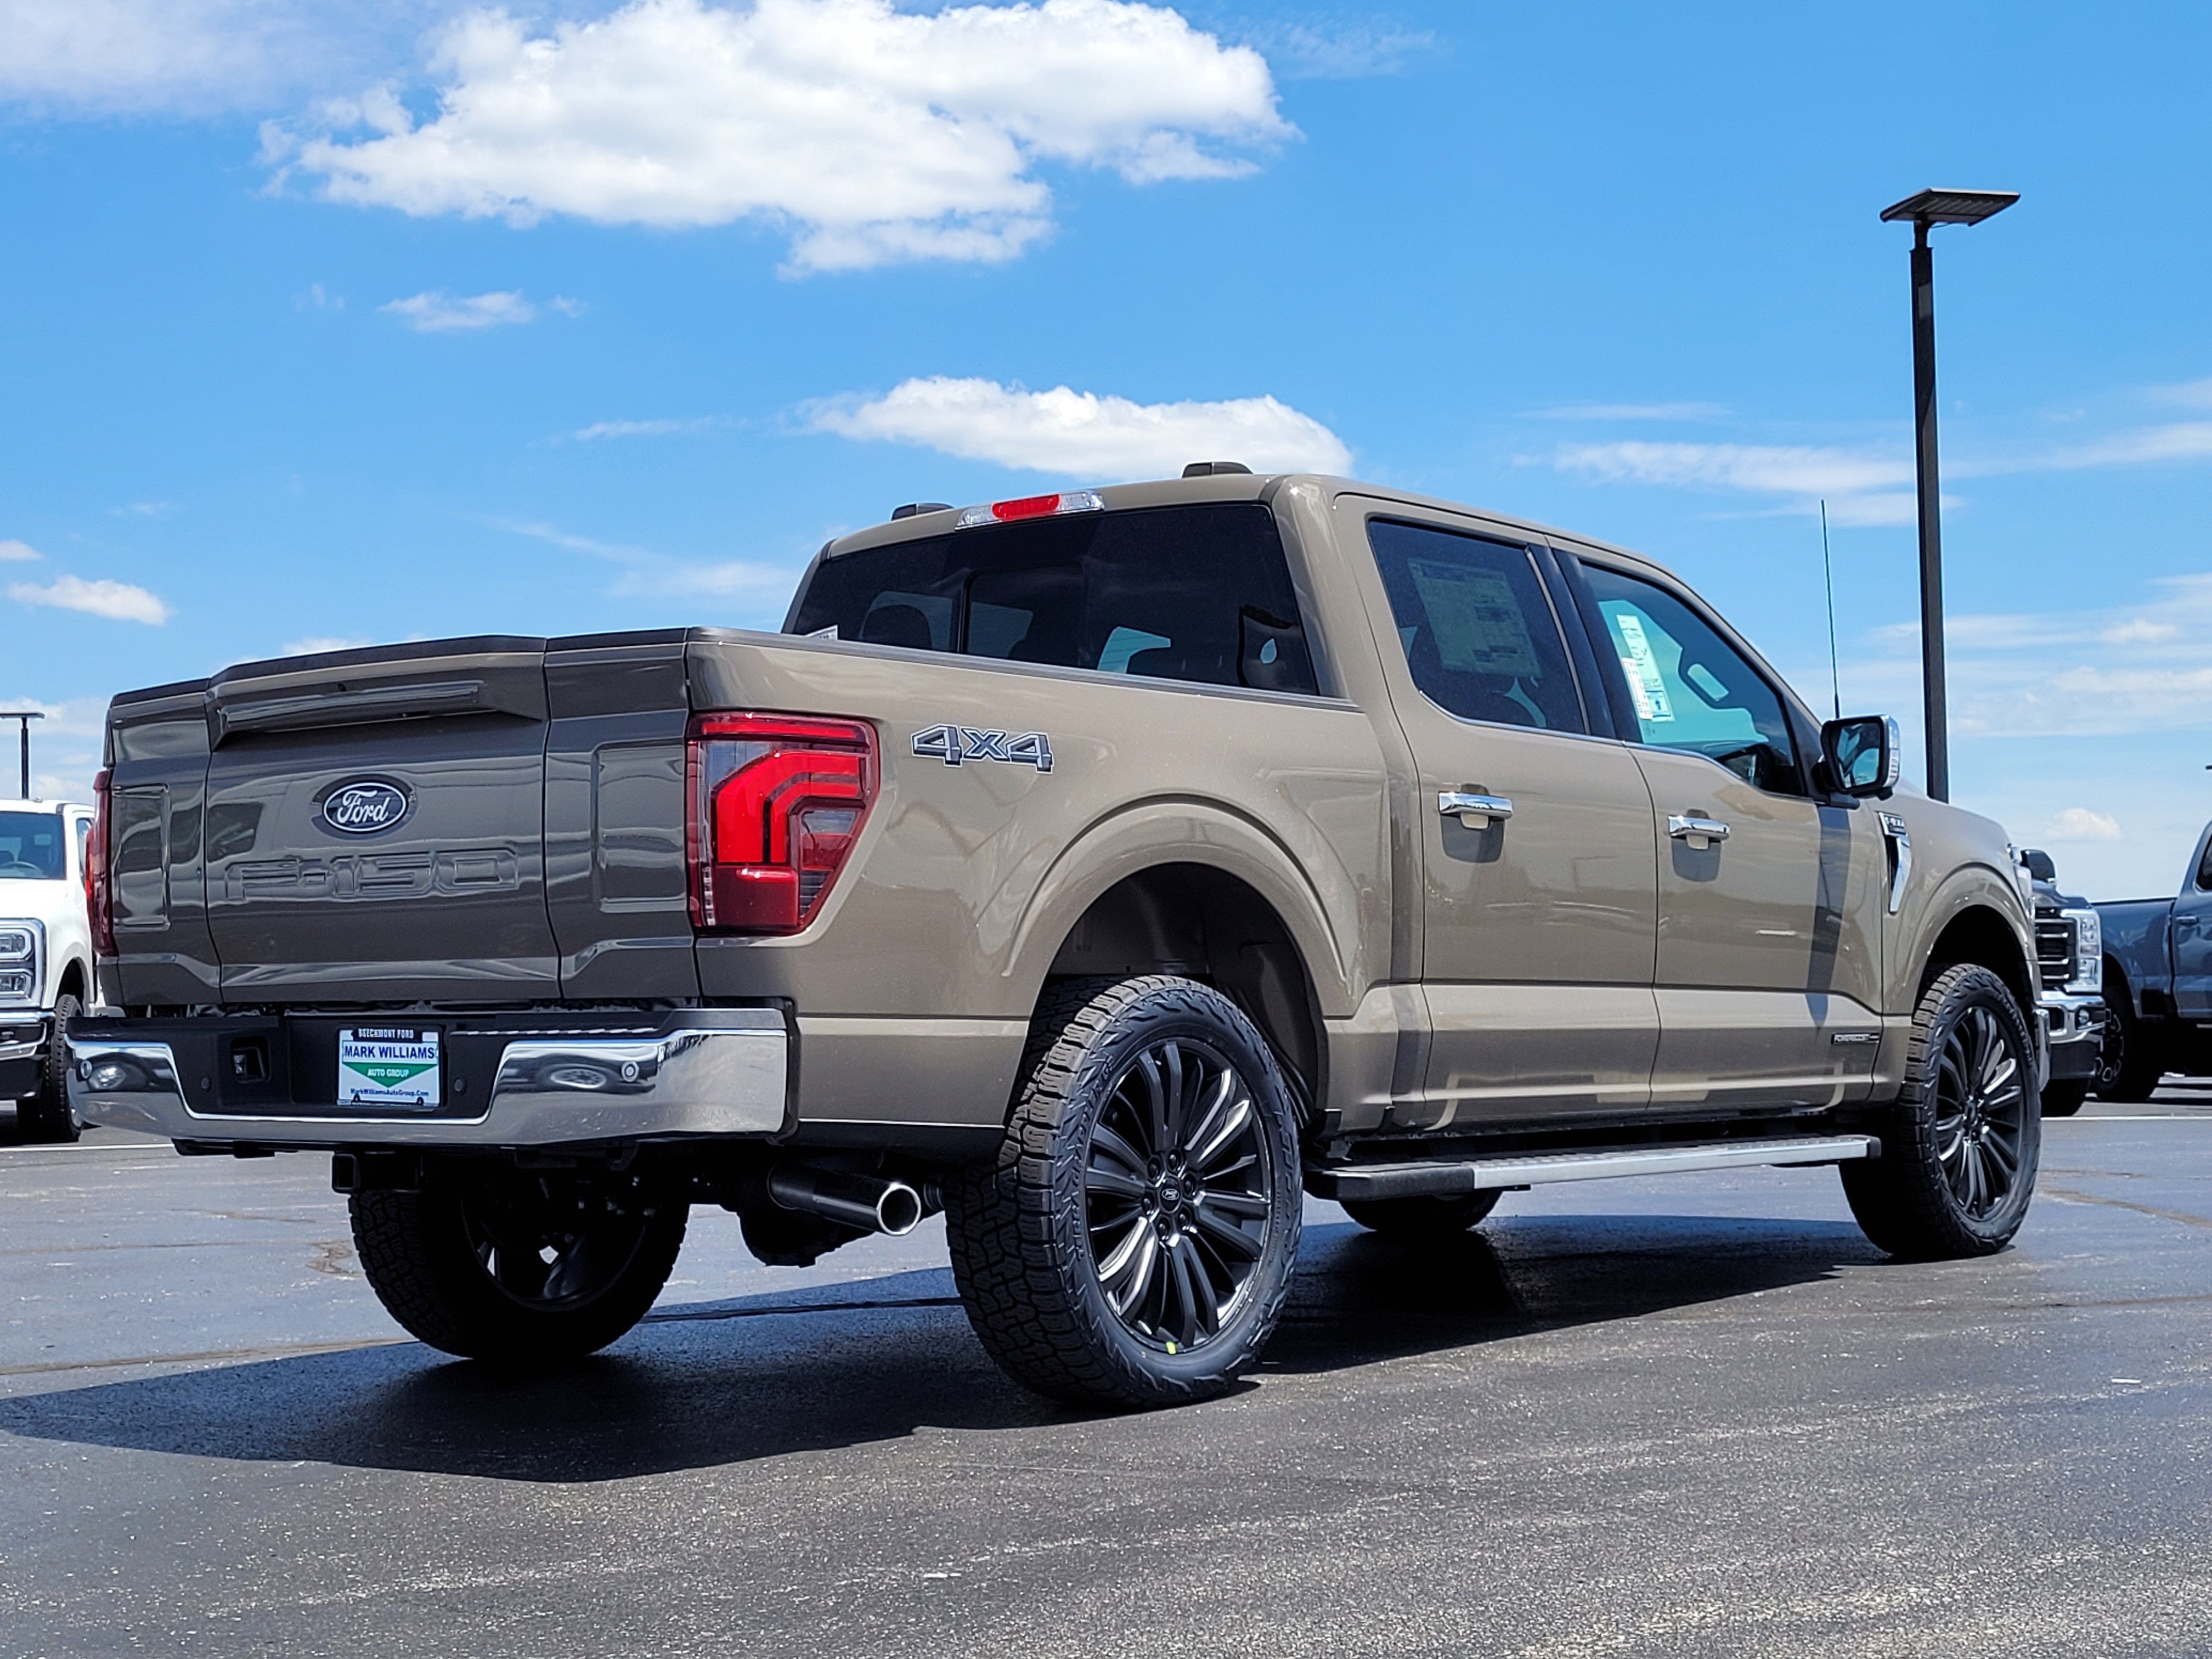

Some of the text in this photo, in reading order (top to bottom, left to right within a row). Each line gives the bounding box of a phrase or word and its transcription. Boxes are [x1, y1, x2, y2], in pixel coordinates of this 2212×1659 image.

[337, 789, 390, 823] Ford
[225, 847, 520, 901] F-150
[358, 1028, 414, 1039] BEECHMONT FORD
[344, 1046, 436, 1059] MARK WILLIAMS
[367, 1068, 409, 1077] AUTO GROUP
